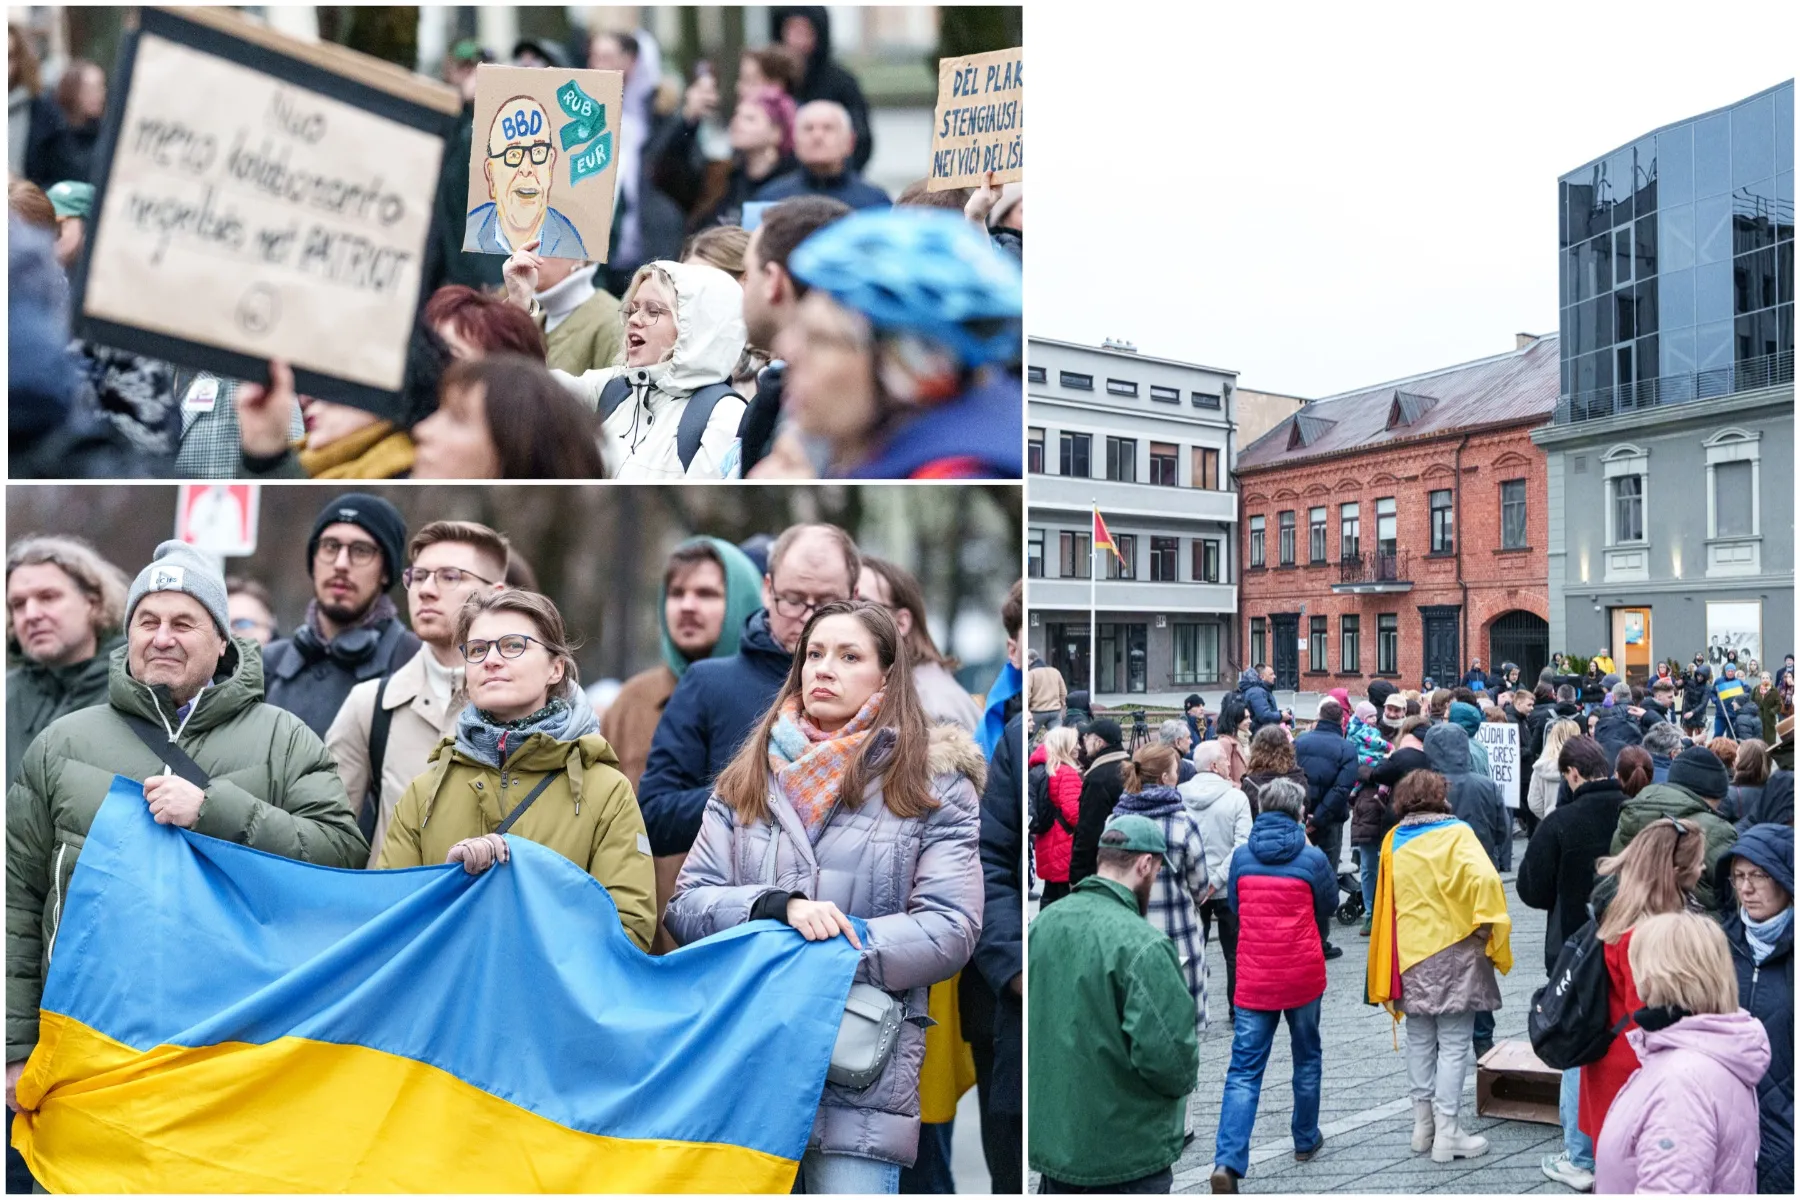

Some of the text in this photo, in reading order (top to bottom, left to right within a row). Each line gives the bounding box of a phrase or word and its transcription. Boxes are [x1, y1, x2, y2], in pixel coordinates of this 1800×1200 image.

[953, 63, 978, 98] DĖL
[563, 90, 592, 116] RUB
[939, 100, 1018, 139] STENGIAUSI
[502, 109, 542, 140] BBD
[577, 143, 607, 174] EUR
[932, 148, 956, 178] NEI
[982, 138, 1003, 173] DĖL
